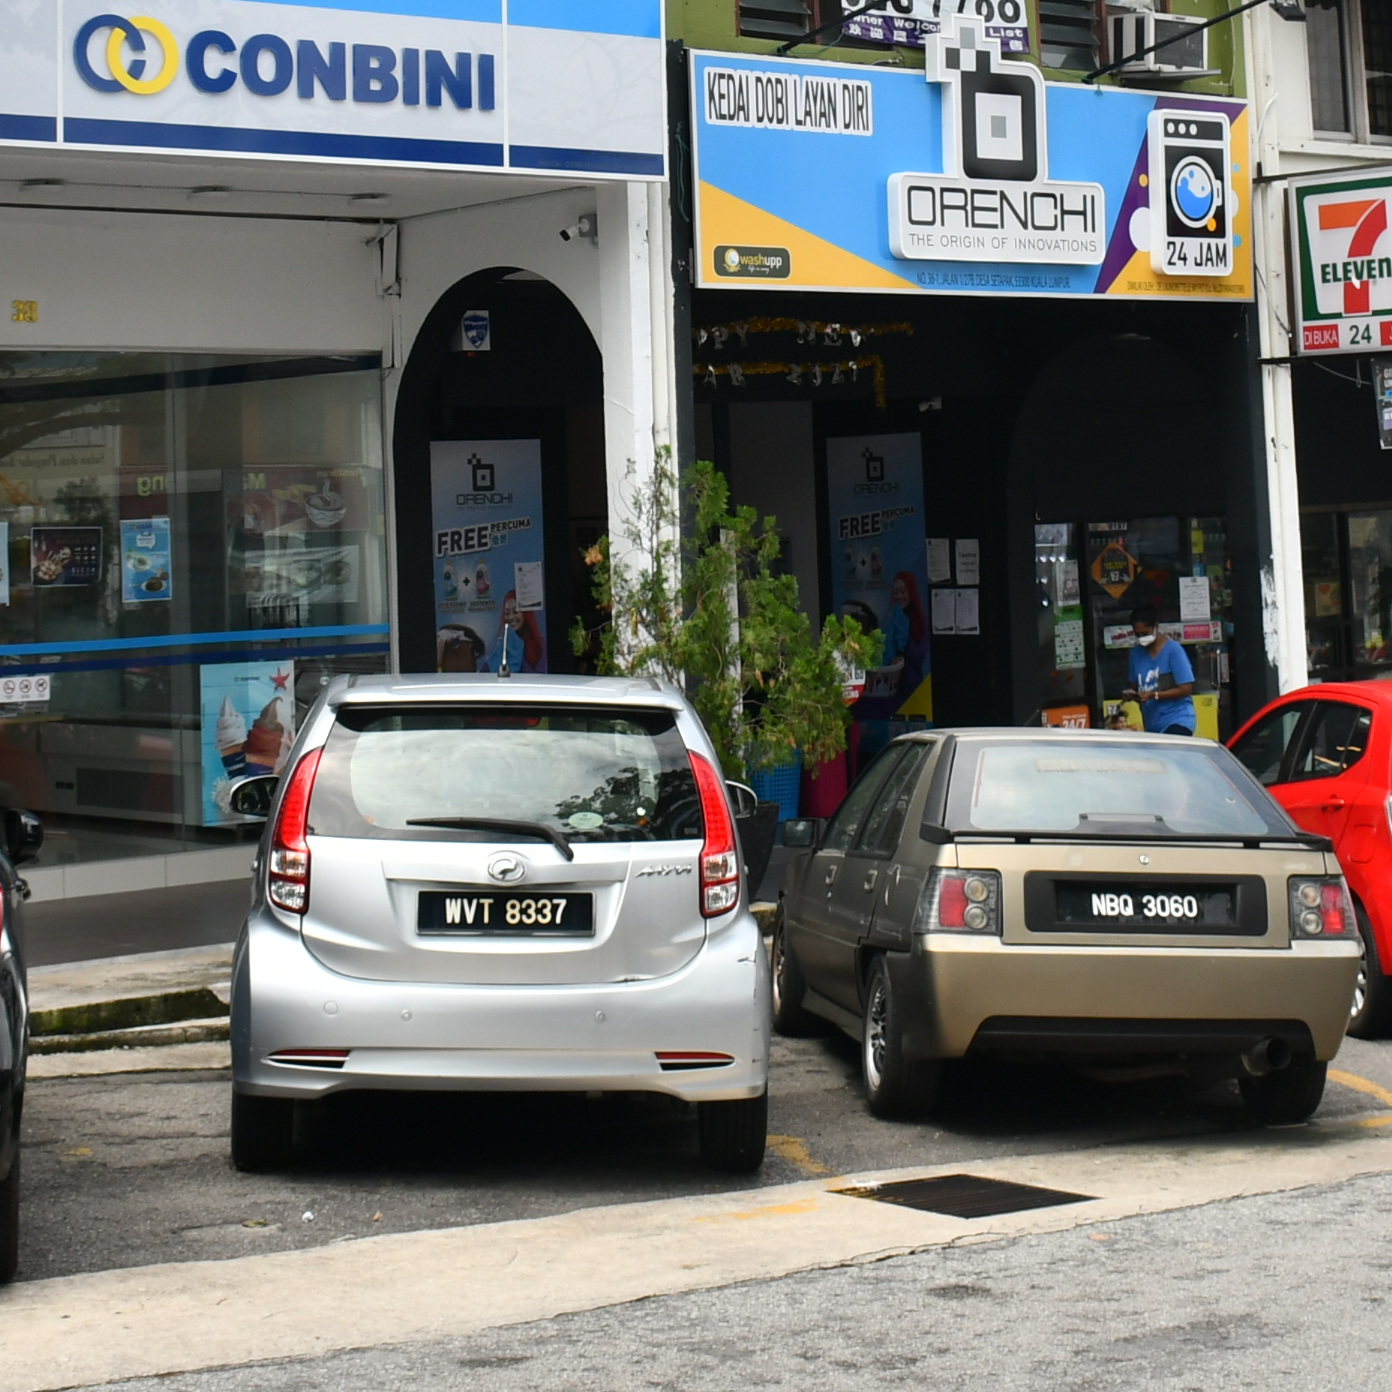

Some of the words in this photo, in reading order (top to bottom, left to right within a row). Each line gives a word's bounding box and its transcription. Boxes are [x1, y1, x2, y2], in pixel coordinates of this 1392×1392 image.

[186, 29, 495, 112] CONBINI
[708, 72, 750, 122] KEDAI
[755, 76, 789, 125] DOBI
[794, 79, 837, 129] LAYAN
[842, 84, 869, 131] DIRI
[907, 185, 1096, 233] ORENCHI
[909, 234, 935, 247] THE
[940, 235, 986, 249] ORIGIN
[991, 237, 1008, 250] OF
[1014, 238, 1097, 253] INNOVATIONS
[1167, 241, 1188, 266] 24
[1194, 242, 1227, 267] JAM
[741, 254, 782, 269] washupp
[1304, 330, 1313, 348] DI
[1314, 327, 1338, 346] BUKA
[1349, 323, 1372, 345] 24
[457, 493, 513, 506] ORENCHI
[491, 518, 531, 532] PERCUMA
[839, 513, 880, 538] FREE
[437, 526, 490, 555] FREE
[445, 897, 494, 924] WVT
[505, 899, 568, 925] 8337
[1091, 894, 1134, 917] NBQ
[1142, 895, 1199, 918] 3060
